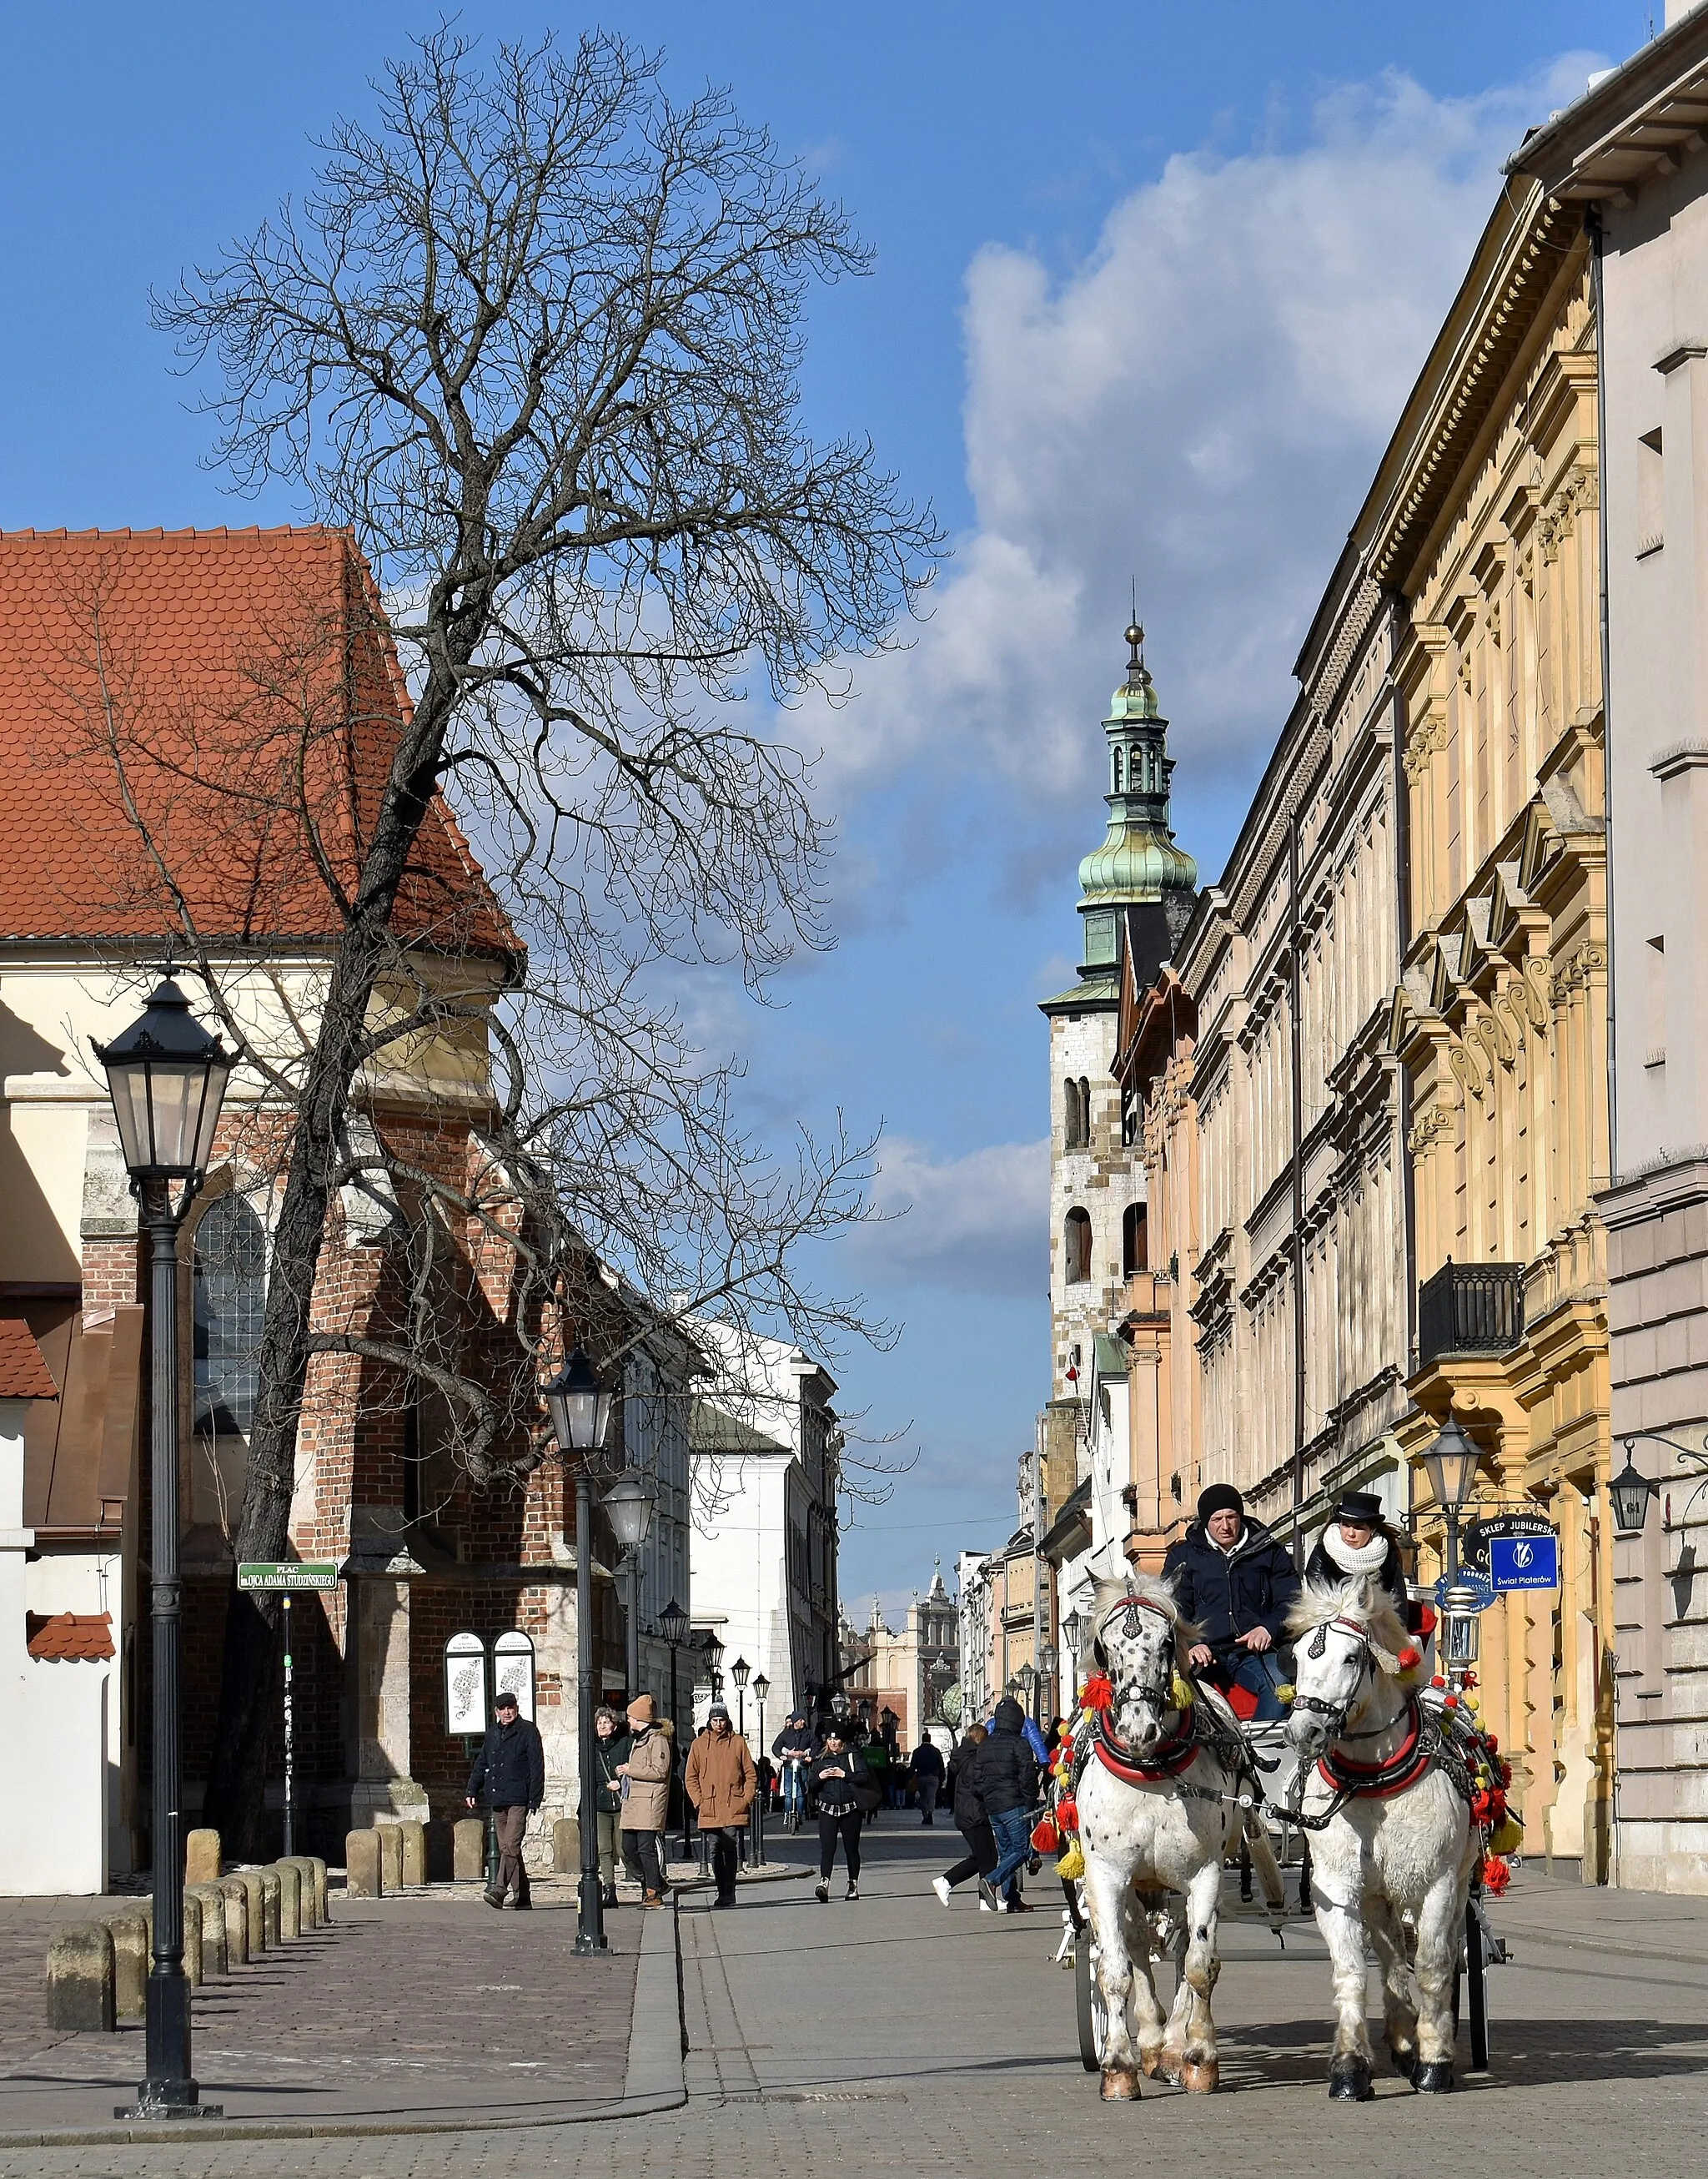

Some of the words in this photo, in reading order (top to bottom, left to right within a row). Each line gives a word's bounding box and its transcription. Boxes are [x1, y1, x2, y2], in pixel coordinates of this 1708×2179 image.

[1479, 1522, 1505, 1537] SKLEP
[276, 1566, 299, 1574] PLAC
[264, 1574, 287, 1587] ADAMA
[287, 1573, 334, 1587] STUDZIŃSKIEGO
[1497, 1576, 1517, 1586] Świat
[1519, 1575, 1551, 1584] Platerów
